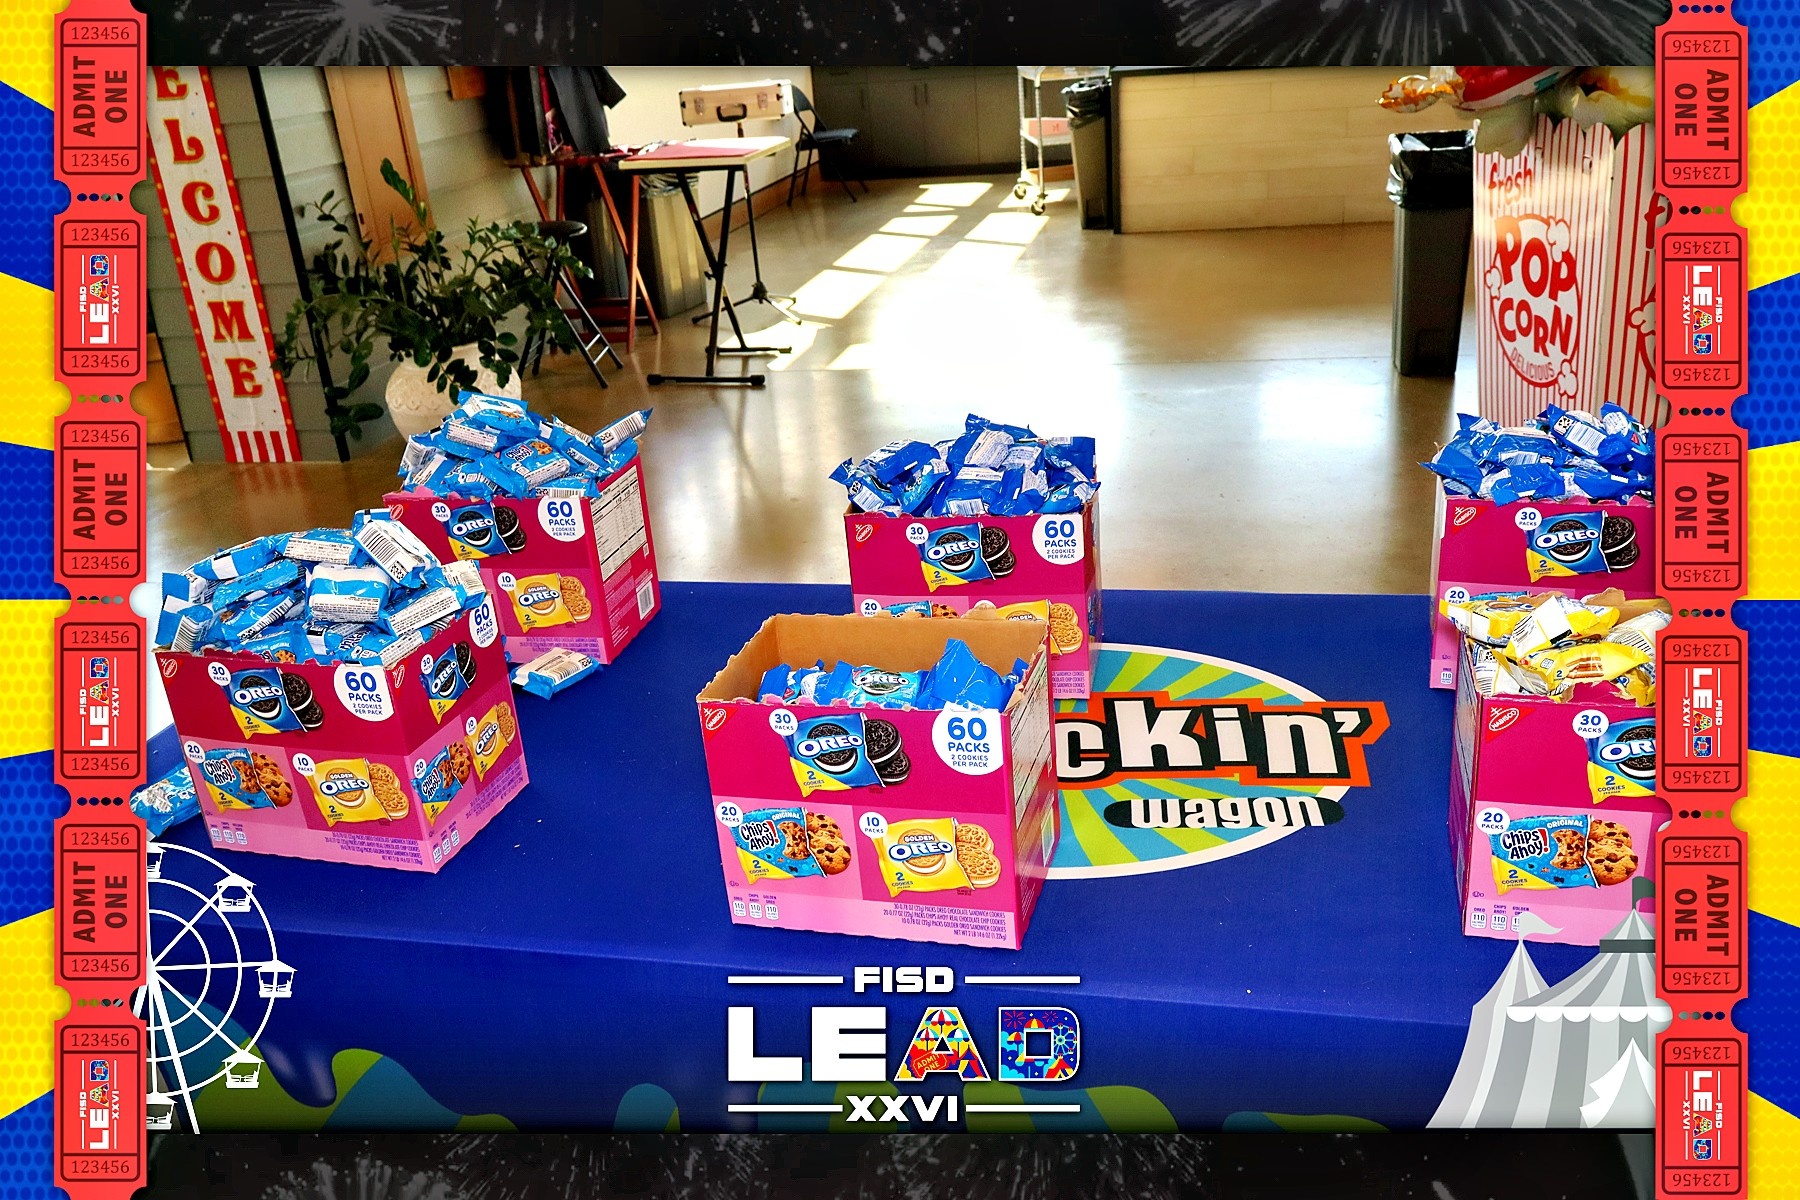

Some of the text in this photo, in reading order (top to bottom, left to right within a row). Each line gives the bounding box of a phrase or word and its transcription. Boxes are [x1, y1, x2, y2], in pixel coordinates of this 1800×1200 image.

[1488, 156, 1533, 213] fresh
[1495, 215, 1577, 302] POP
[1499, 298, 1573, 357] CORN
[1510, 347, 1555, 382] DELICIOUS
[434, 505, 446, 514] 30
[547, 501, 573, 518] 60
[1520, 511, 1537, 521] 30
[452, 518, 494, 536] OREO
[548, 518, 576, 526] PACKS
[910, 526, 924, 535] 30
[1044, 519, 1075, 539] 60
[1044, 538, 1077, 548] PACKS
[1535, 528, 1600, 549] OREO
[927, 539, 980, 560] OREO
[1539, 559, 1548, 568] 2
[501, 575, 511, 583] 10
[934, 571, 941, 579] 2
[518, 590, 560, 607] OREO
[1450, 590, 1465, 599] 20
[865, 602, 877, 611] 20
[474, 603, 490, 626] 60
[476, 619, 493, 634] PACKS
[422, 656, 431, 666] 30
[211, 665, 225, 676] 30
[344, 671, 377, 692] 60
[431, 660, 457, 695] OREO
[234, 686, 282, 704] OREO
[348, 692, 382, 703] PACKS
[245, 716, 253, 725] 2
[774, 713, 791, 724] 30
[1491, 709, 1517, 730] NABISCO
[1580, 714, 1602, 726] 30
[947, 716, 987, 740] 60
[1578, 726, 1602, 734] PACKS
[476, 722, 498, 755] OREO
[188, 744, 200, 754] 20
[797, 735, 863, 758] OREO
[947, 741, 990, 753] PACKS
[1600, 741, 1656, 763] OR
[298, 757, 308, 767] 10
[957, 754, 989, 762] COOKIES
[205, 760, 226, 776] Chips
[806, 770, 816, 781] 2
[1605, 775, 1616, 786] 2
[320, 779, 369, 796] OREO
[1597, 784, 1626, 793] COOKIES
[219, 792, 226, 800] 2
[329, 805, 337, 813] 2
[721, 805, 737, 816] 20
[1130, 796, 1326, 829] wagon
[772, 811, 801, 820] ORIGINAL
[1483, 811, 1503, 823] 20
[866, 816, 880, 827] 10
[1481, 823, 1504, 831] PACKS
[1547, 818, 1583, 829] ORIGINAL
[741, 821, 769, 841] Chips
[750, 821, 779, 850] Ahoy!
[1502, 829, 1540, 853] Chips
[1510, 828, 1549, 860] Ahoy!
[889, 841, 953, 861] OREO
[752, 859, 761, 869] 2
[895, 871, 905, 881] 2
[1508, 869, 1518, 879] 2
[734, 902, 745, 910] 110
[750, 904, 761, 912] 110
[766, 905, 777, 913] 110
